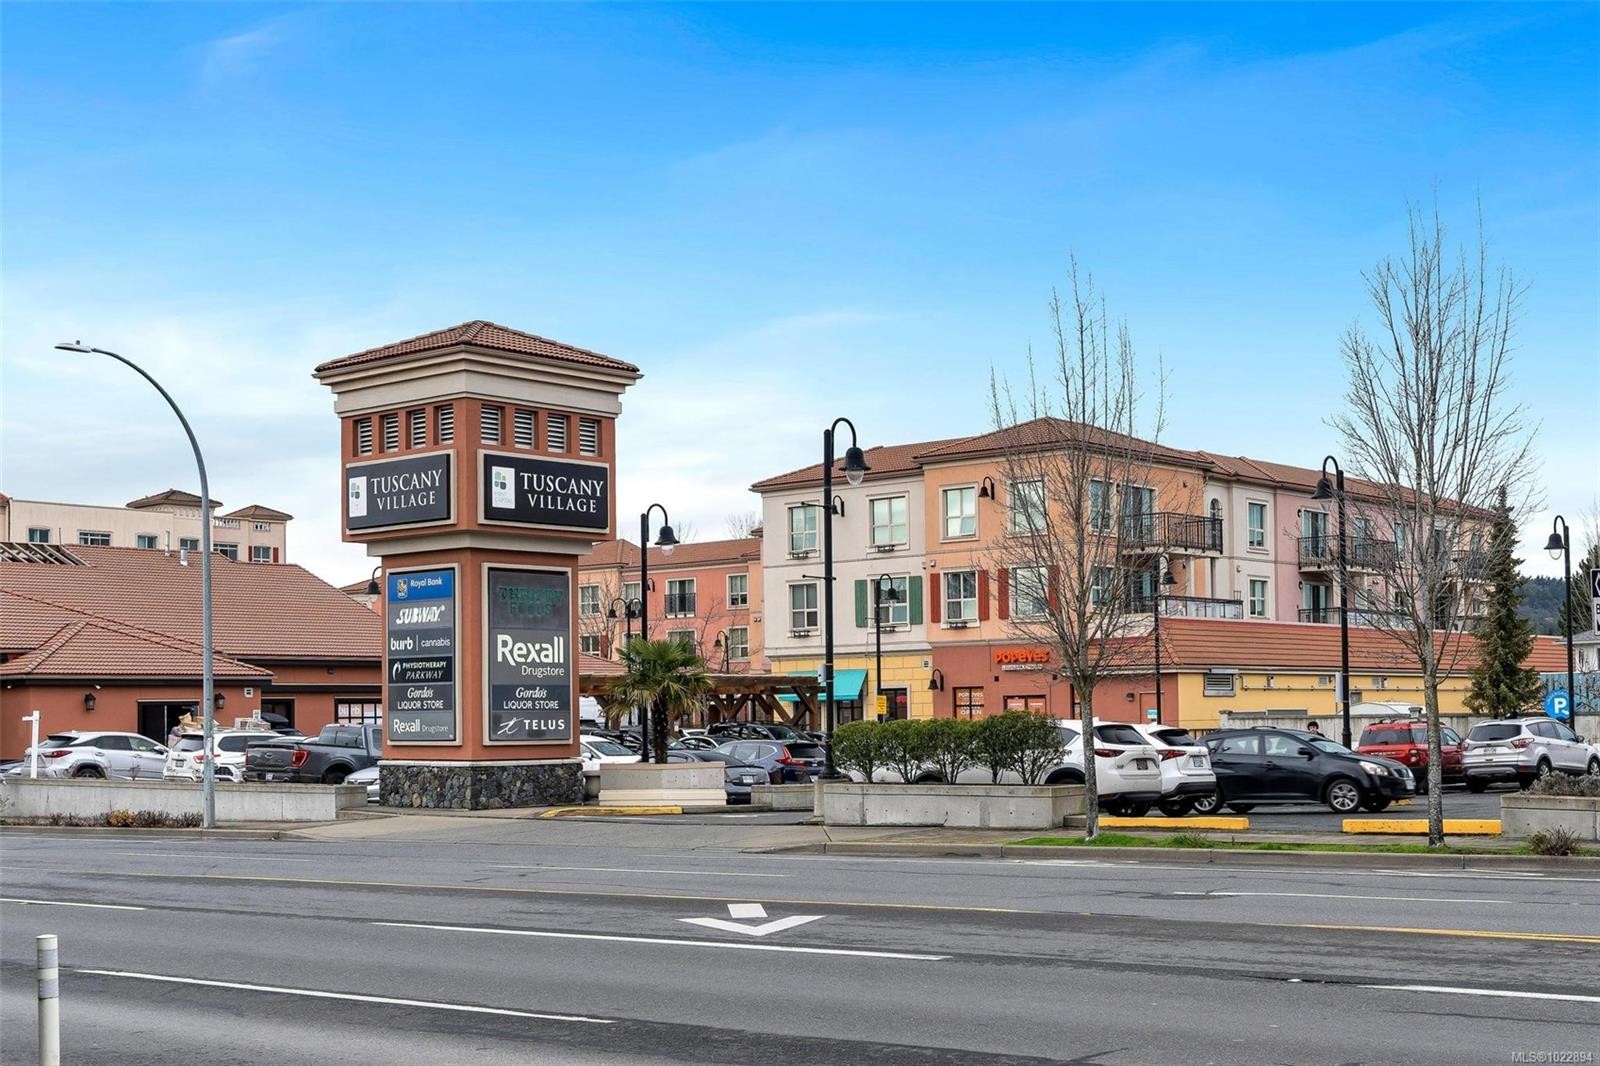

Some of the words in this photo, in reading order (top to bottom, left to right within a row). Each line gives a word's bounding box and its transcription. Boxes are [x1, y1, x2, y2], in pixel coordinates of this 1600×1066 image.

[371, 469, 442, 494] TUSCANY
[520, 472, 604, 497] TUSCANY
[377, 491, 436, 511] VILLAGE
[527, 493, 597, 513] VILLAGE
[410, 578, 427, 589] Royal
[427, 576, 443, 586] Bank
[395, 605, 445, 625] SUBWAY
[390, 636, 414, 651] burb
[420, 637, 451, 647] cannabis
[497, 634, 564, 666] Rexall
[402, 661, 447, 669] PHYSIOTHERAPY
[521, 665, 565, 678] Drugstore
[405, 670, 444, 680] PARKWAY
[407, 686, 434, 699] Gordo's
[515, 686, 548, 699] Gordo's
[397, 700, 422, 710] LIQUOR
[423, 700, 444, 709] STORE
[503, 700, 533, 710] LIQUOR
[535, 700, 559, 709] STORE
[393, 718, 421, 735] Rexall
[421, 724, 449, 734] Drugstore
[523, 719, 565, 730] TELUS
